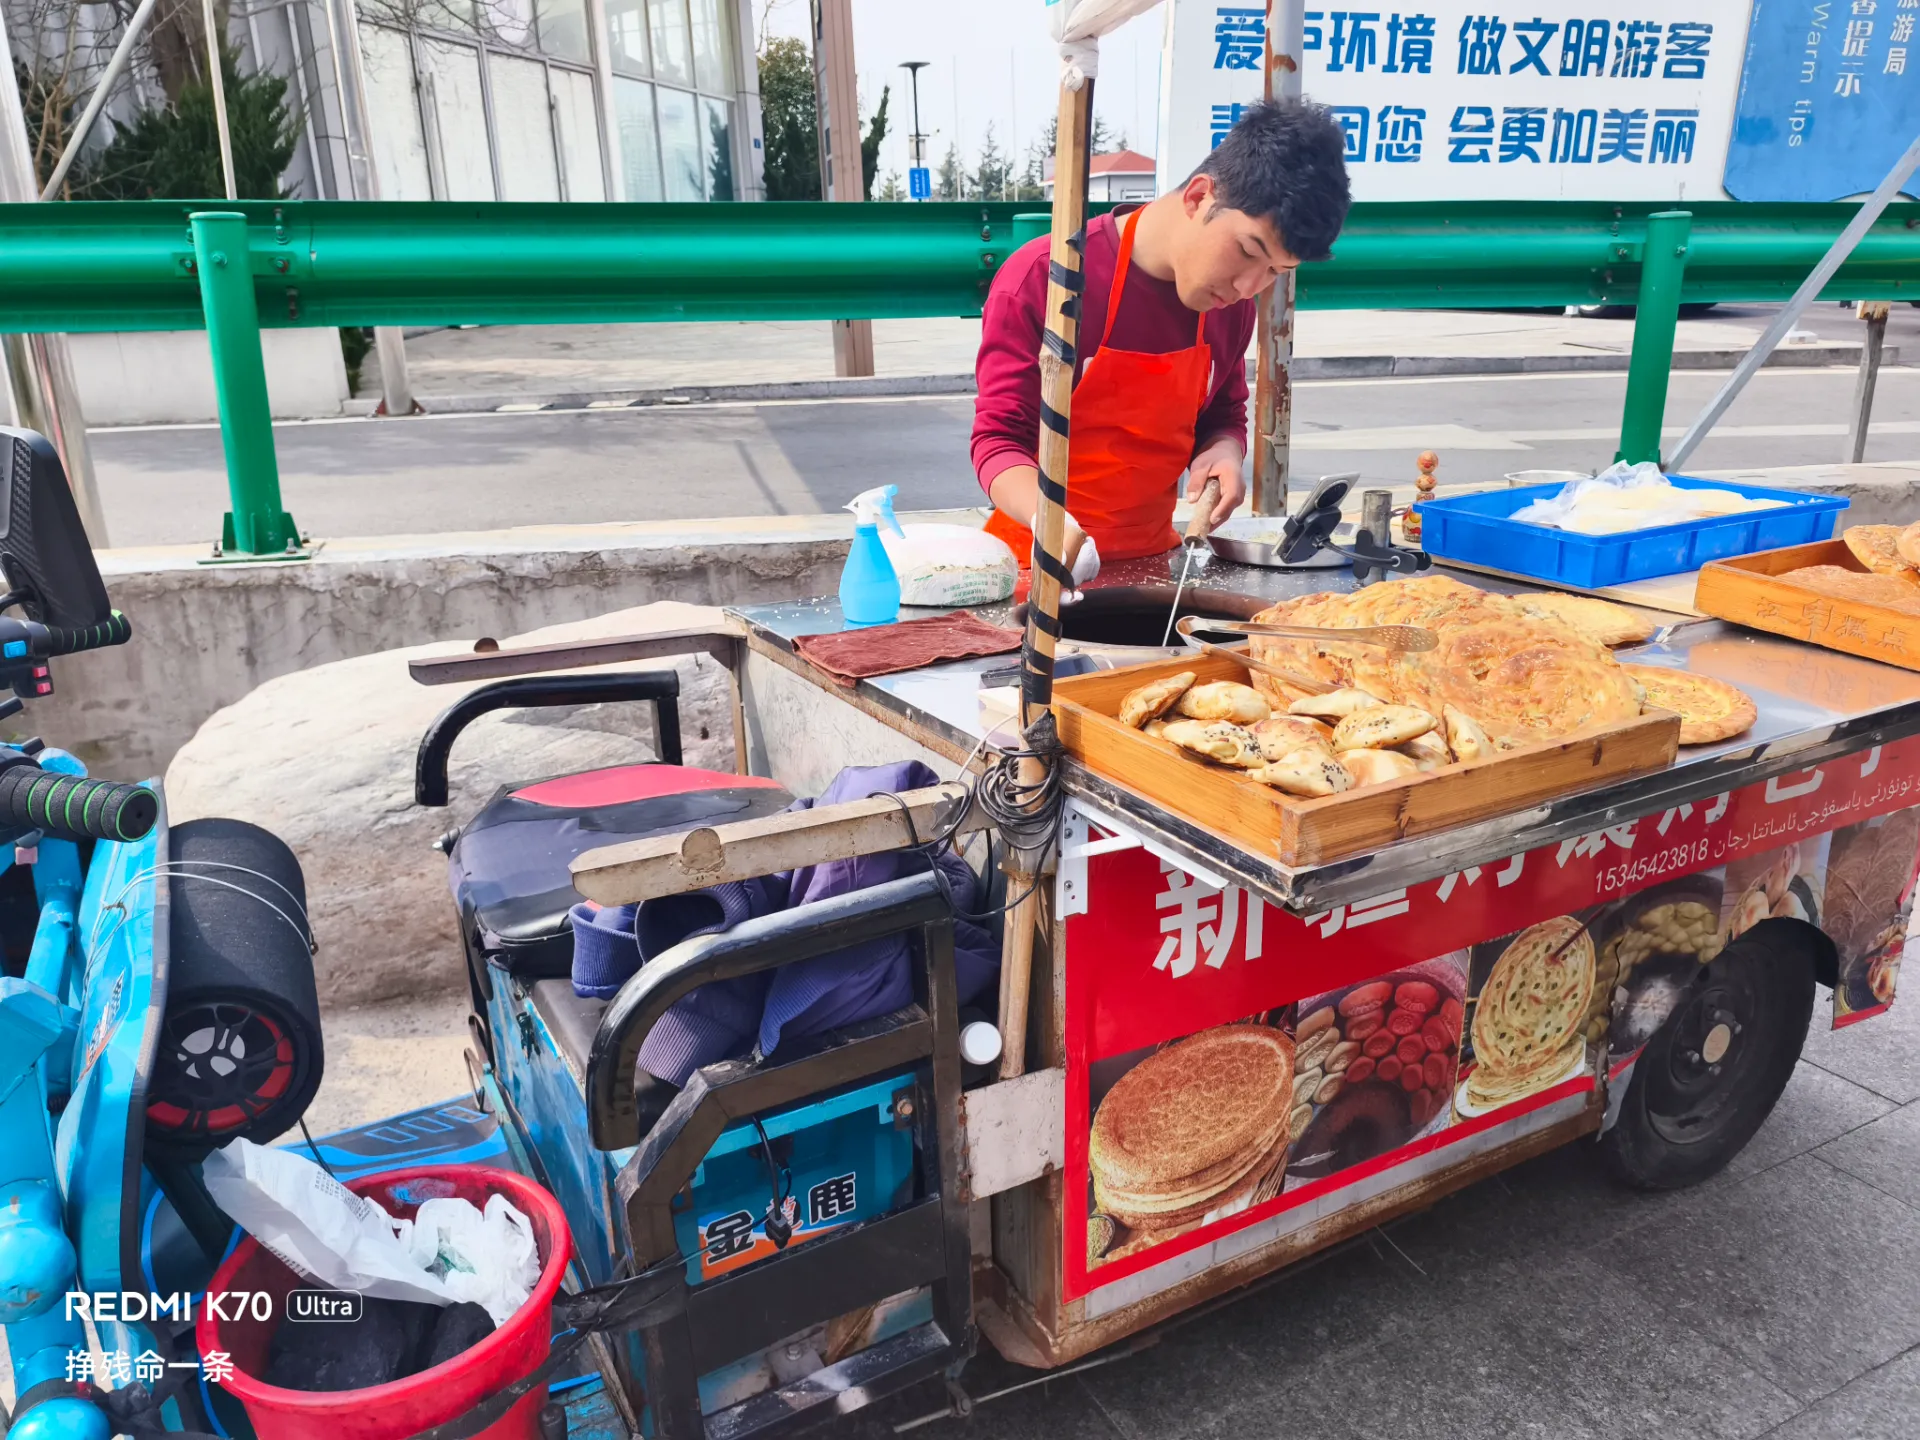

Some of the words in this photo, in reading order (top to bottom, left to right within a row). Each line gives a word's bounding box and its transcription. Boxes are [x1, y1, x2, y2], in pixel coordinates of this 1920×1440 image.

[1457, 15, 1714, 79] 做文明游客
[1800, 3, 1831, 82] Warm
[1883, 0, 1918, 75] 游局
[1210, 103, 1427, 163] 因您
[1448, 106, 1700, 164] 会更加美丽
[1789, 99, 1811, 147] tips
[1595, 838, 1709, 893] 15345423818
